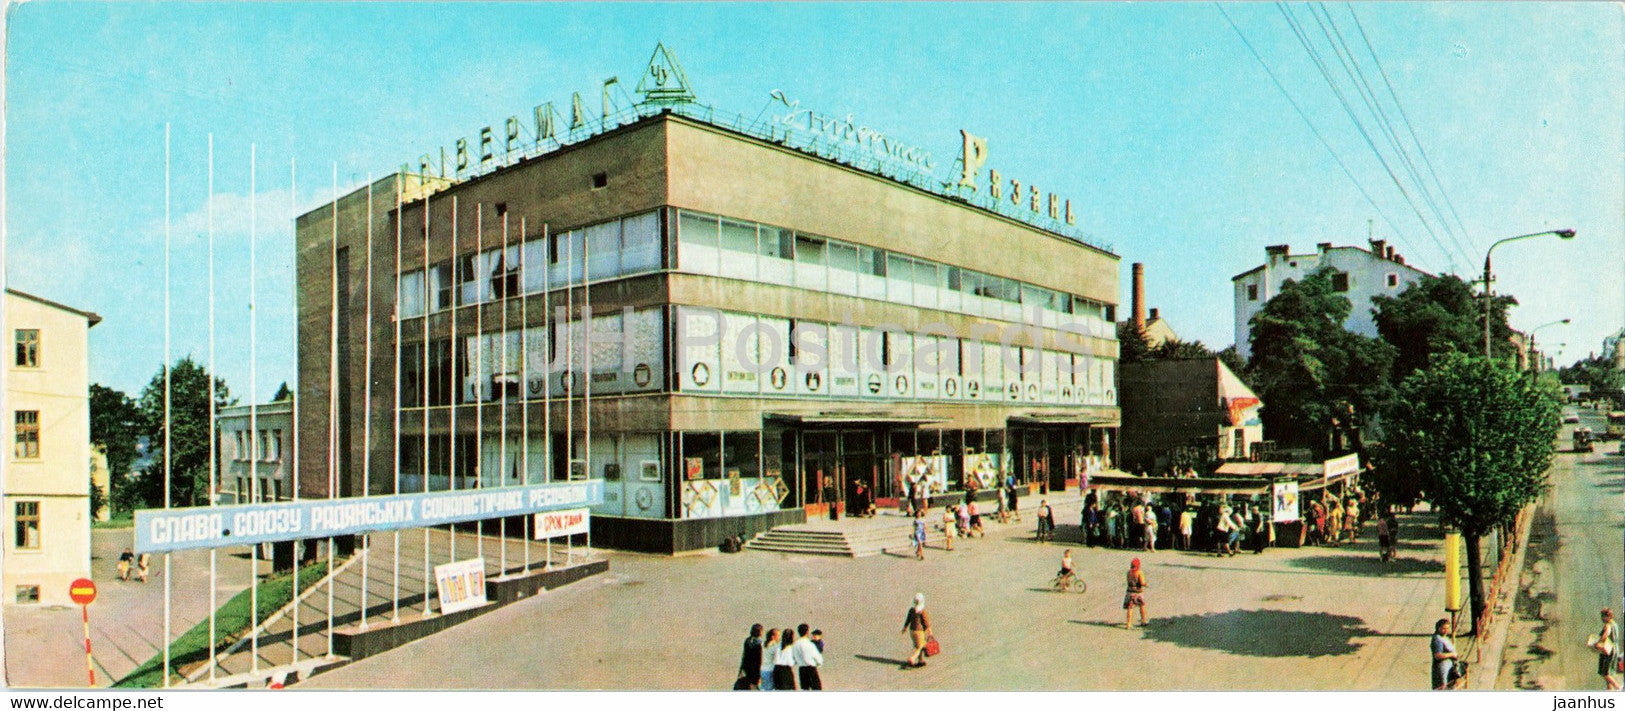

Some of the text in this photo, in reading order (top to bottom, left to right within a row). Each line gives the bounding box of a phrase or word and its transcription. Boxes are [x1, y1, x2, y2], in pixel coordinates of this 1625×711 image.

[150, 512, 222, 544] СЛАВА
[233, 508, 302, 537] СОЮЗУ
[311, 498, 414, 531] РАДЯНСЬКИХ
